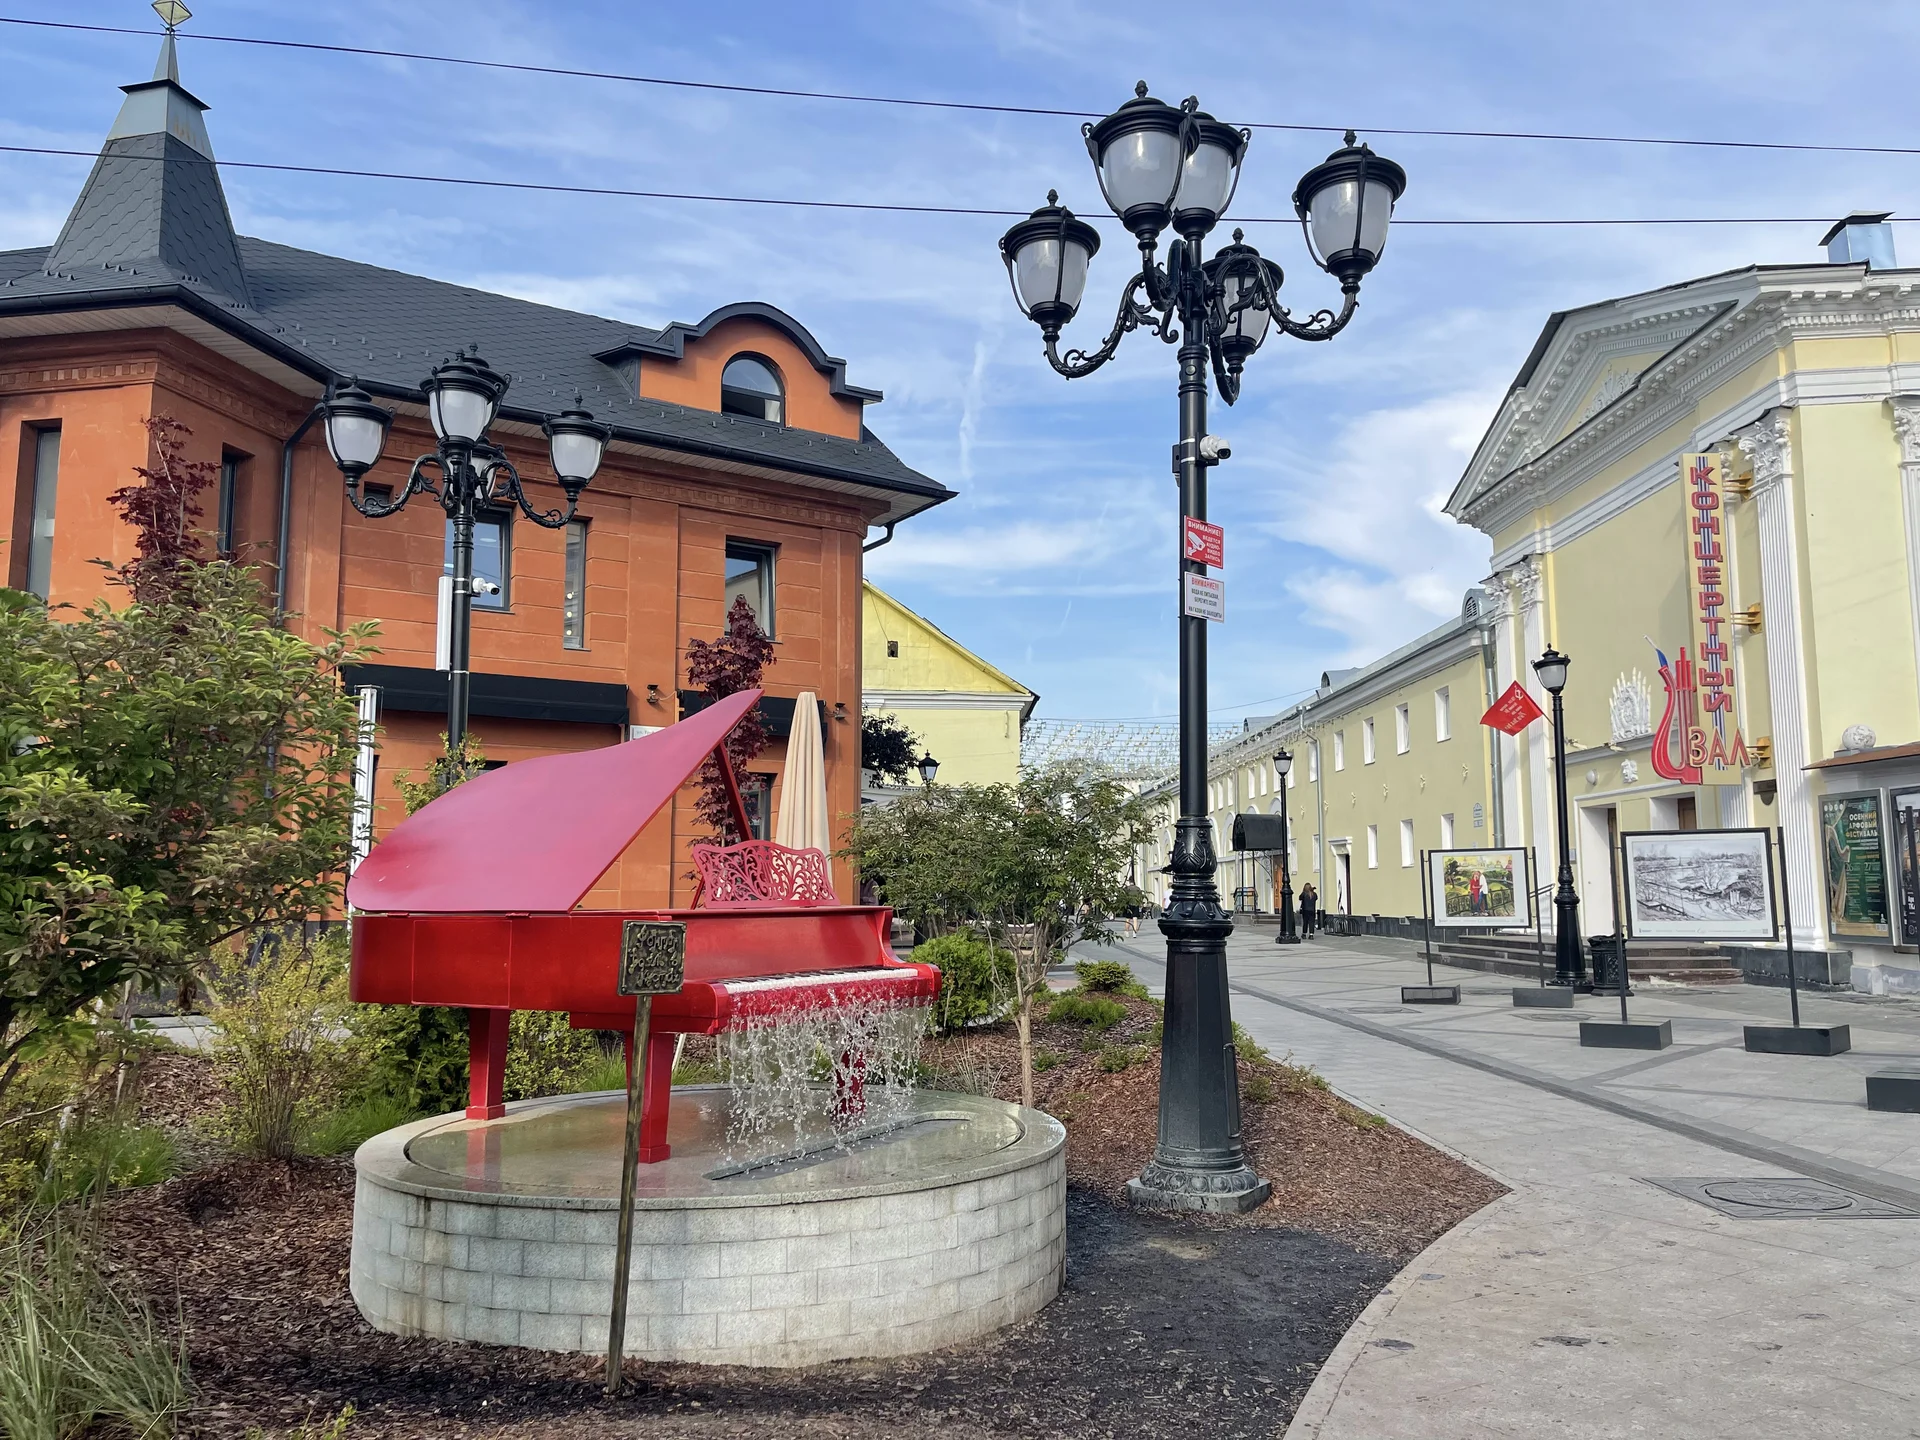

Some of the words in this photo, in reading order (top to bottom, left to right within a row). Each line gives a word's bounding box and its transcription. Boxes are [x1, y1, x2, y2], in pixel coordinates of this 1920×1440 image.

[1187, 520, 1221, 537] ВНИМАНИЕ!
[1689, 466, 1733, 713] КОНЦЕРТНЫЙ
[1688, 726, 1751, 767] ЗАЛ
[1849, 811, 1877, 821] ОСЕННИЙ
[1848, 821, 1877, 829] АРФОВЫЙ
[1845, 830, 1878, 838] ФЕСТИВАЛЬ
